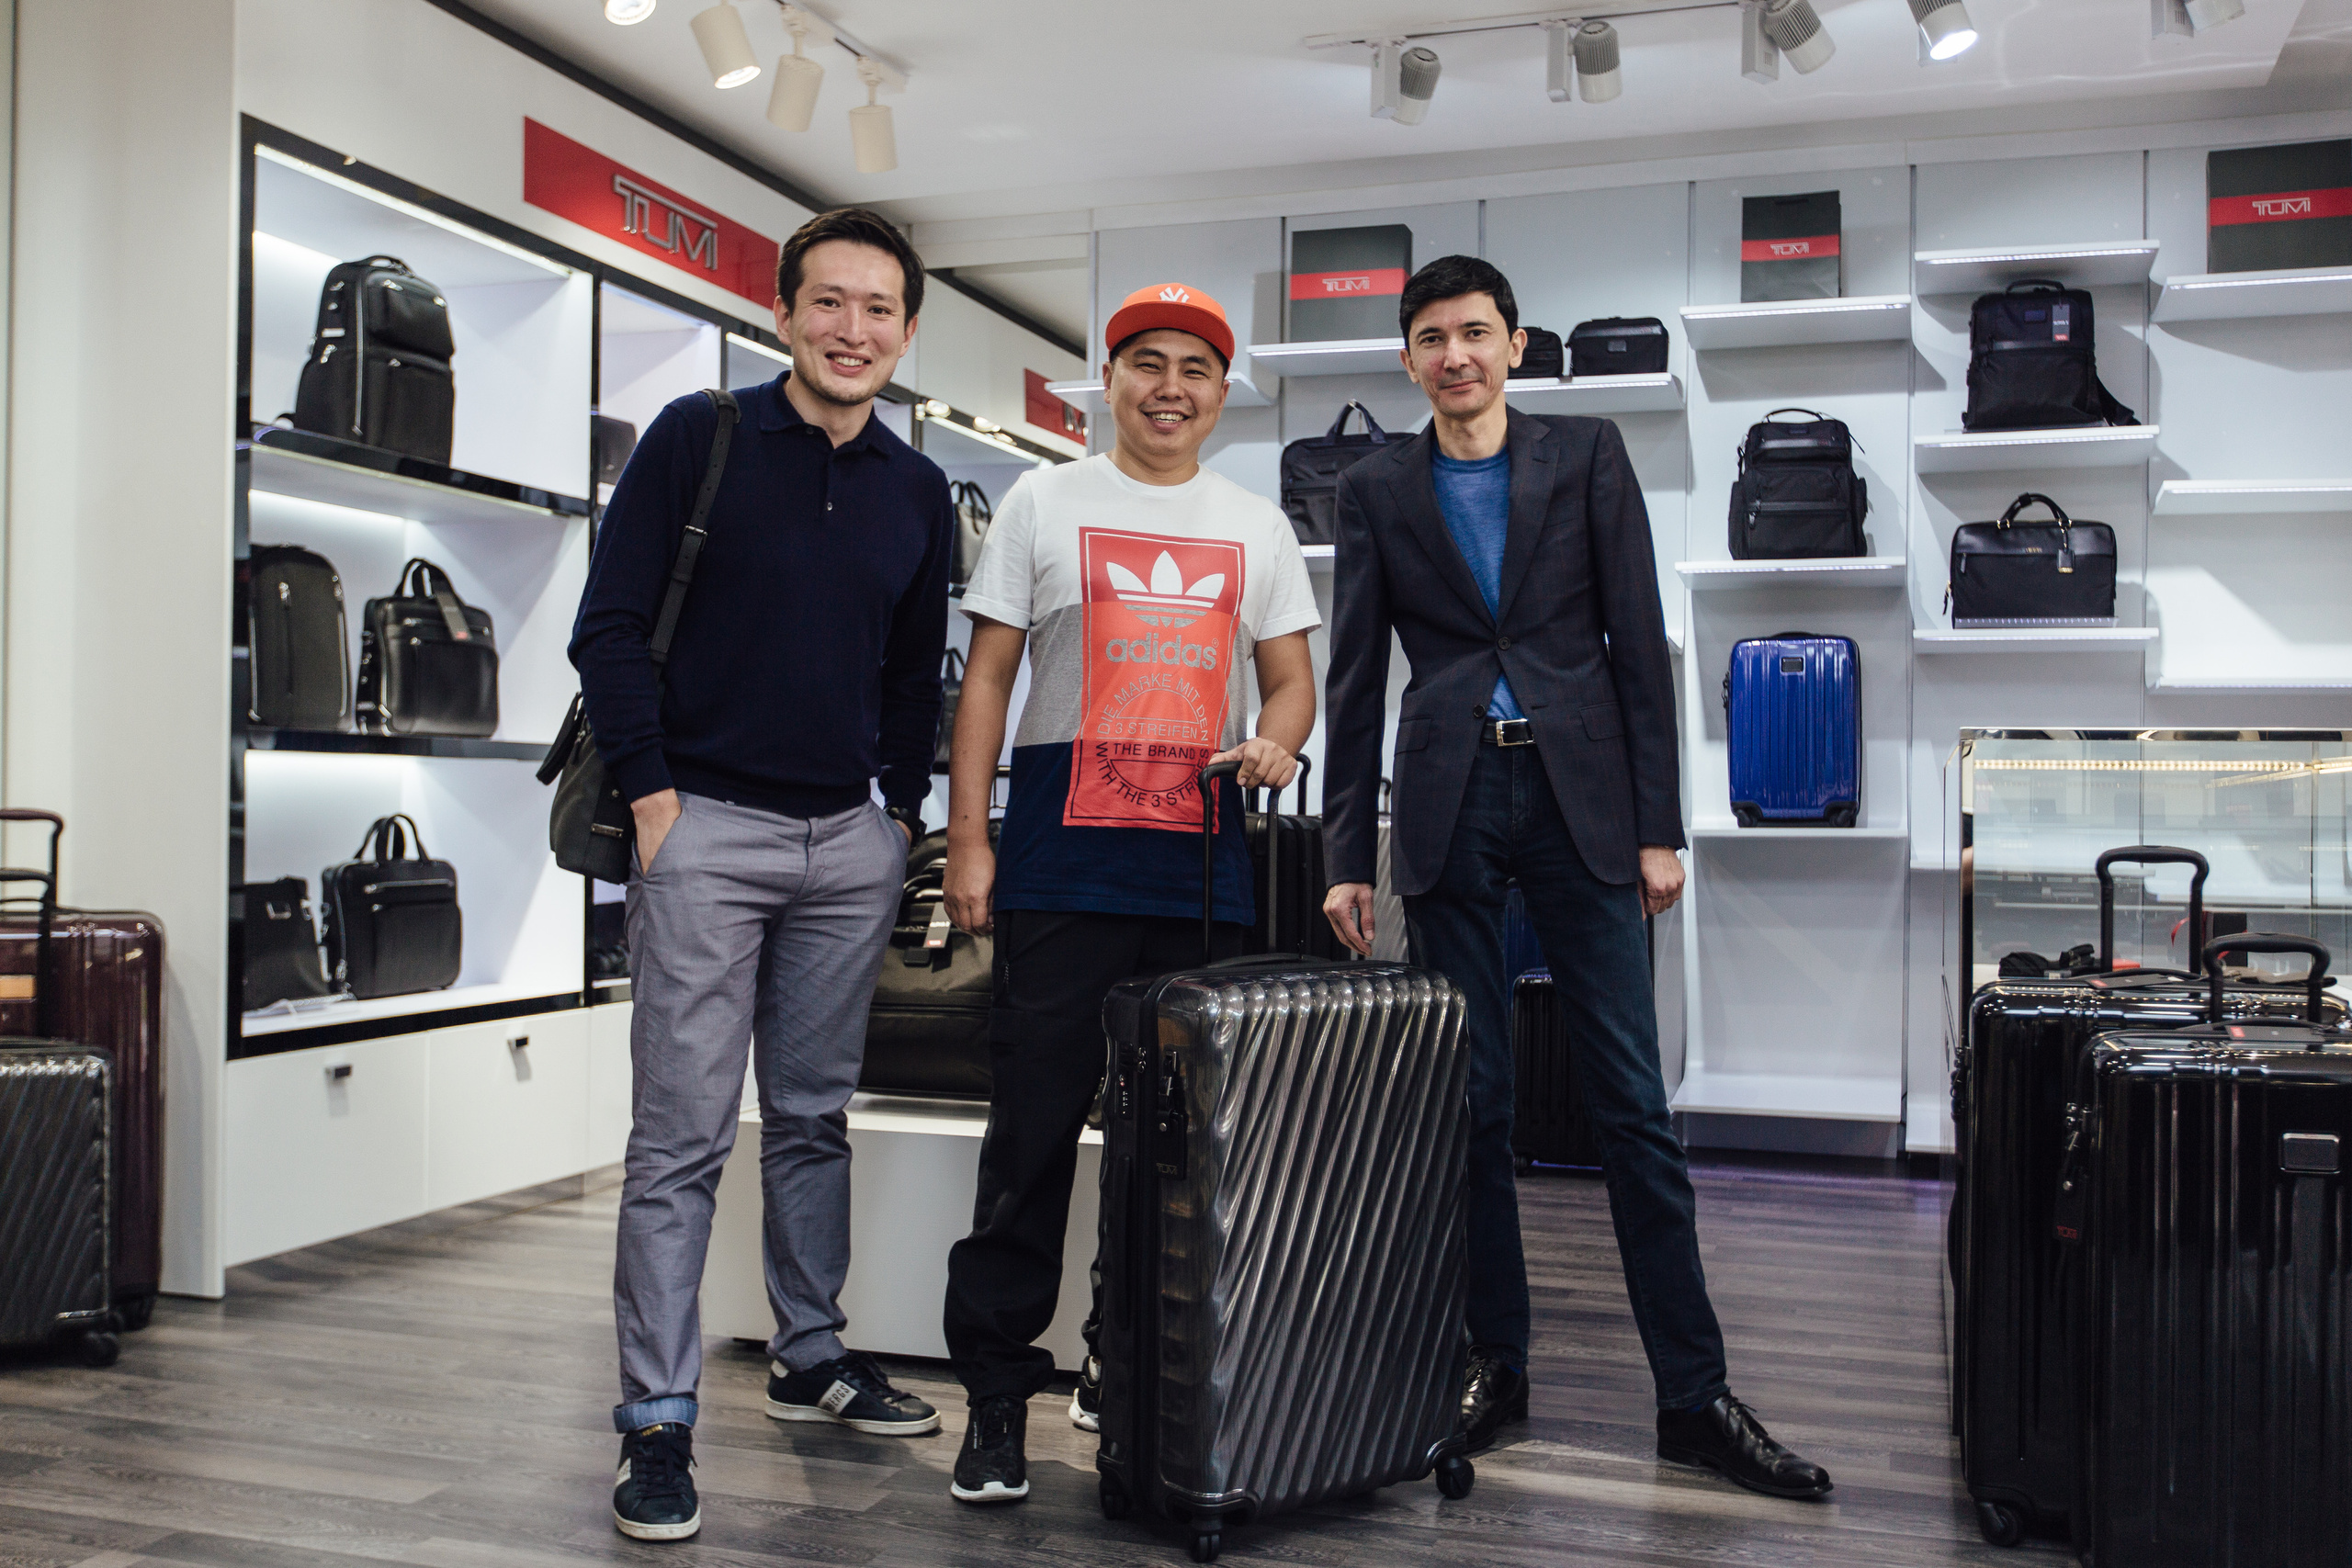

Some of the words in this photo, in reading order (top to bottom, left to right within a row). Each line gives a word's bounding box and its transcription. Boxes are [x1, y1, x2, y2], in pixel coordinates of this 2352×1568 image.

[2252, 197, 2311, 216] TUMI
[613, 174, 718, 271] TUMI
[1770, 242, 1810, 256] TUMI
[1322, 276, 1370, 291] TUMI
[1105, 632, 1217, 671] adidas
[1097, 705, 1118, 734] DIE
[1114, 672, 1172, 705] MARKE
[1176, 677, 1201, 703] MIT
[1196, 704, 1209, 741] DEN
[1114, 722, 1123, 734] 3
[1128, 722, 1197, 739] STREIFEN
[1114, 742, 1142, 756] THE
[1148, 744, 1195, 760] BRAND
[1096, 741, 1117, 785] WITH
[1116, 781, 1148, 807] THE
[1151, 795, 1160, 807] 3
